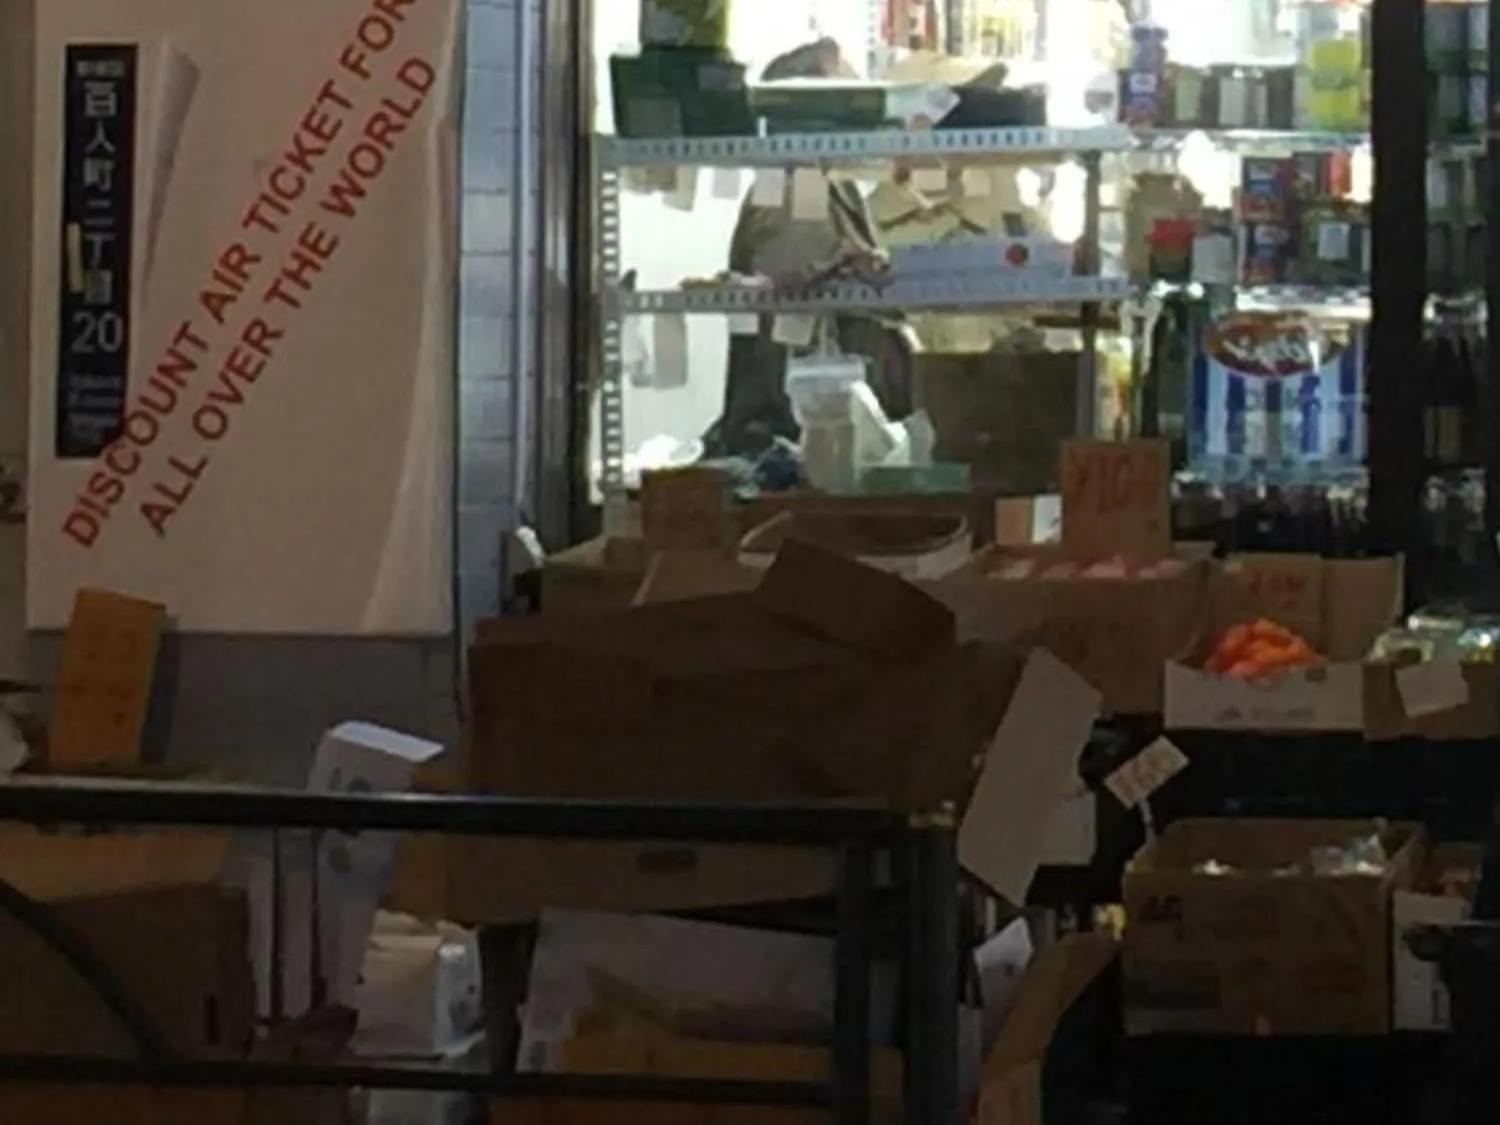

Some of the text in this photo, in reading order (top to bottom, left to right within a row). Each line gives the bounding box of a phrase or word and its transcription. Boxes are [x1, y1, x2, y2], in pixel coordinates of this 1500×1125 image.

[62, 320, 208, 548] DISCOUNT
[199, 243, 261, 324] AIR
[242, 79, 354, 235] TICKET
[71, 311, 123, 353] 20
[139, 57, 436, 538] ALL OVER THE WORLD
